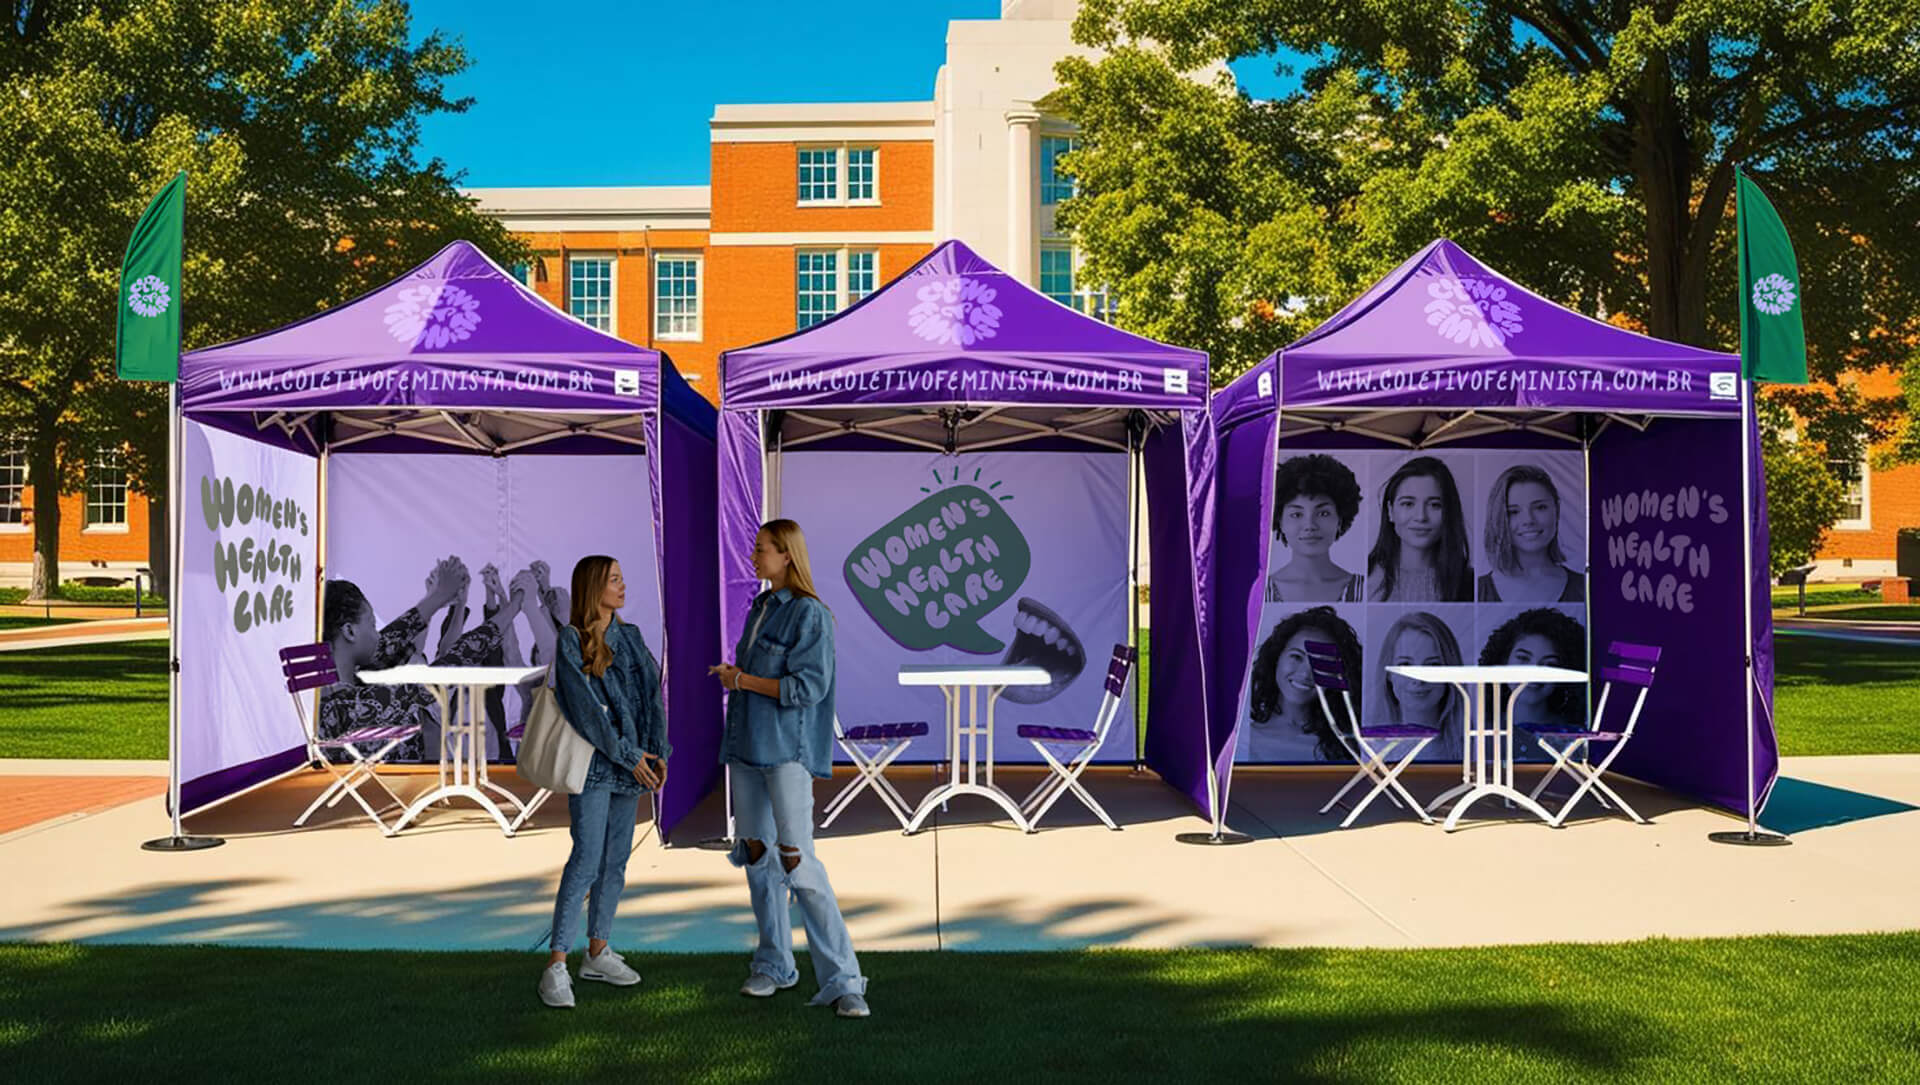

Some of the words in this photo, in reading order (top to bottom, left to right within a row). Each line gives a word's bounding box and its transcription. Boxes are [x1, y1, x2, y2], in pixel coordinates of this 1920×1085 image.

[219, 369, 594, 393] WWW.COLETIVOFEMINISTA.COM.BR
[768, 369, 1143, 393] WWW.COLETIVOFEMINISTA.COM.BR
[1317, 369, 1692, 393] WWW.COLETIVOFEMINISTA.COM.BR
[201, 475, 308, 532] WOMEN'S
[1601, 485, 1729, 531] WOMEN'S
[214, 537, 301, 593] HEALTH
[851, 498, 991, 589] WOMEN'S
[1608, 530, 1710, 579] HEALTH
[884, 534, 1000, 616] HEALTH
[924, 568, 1004, 629] CARE
[1621, 570, 1694, 613] CARE
[233, 584, 294, 633] CARE
